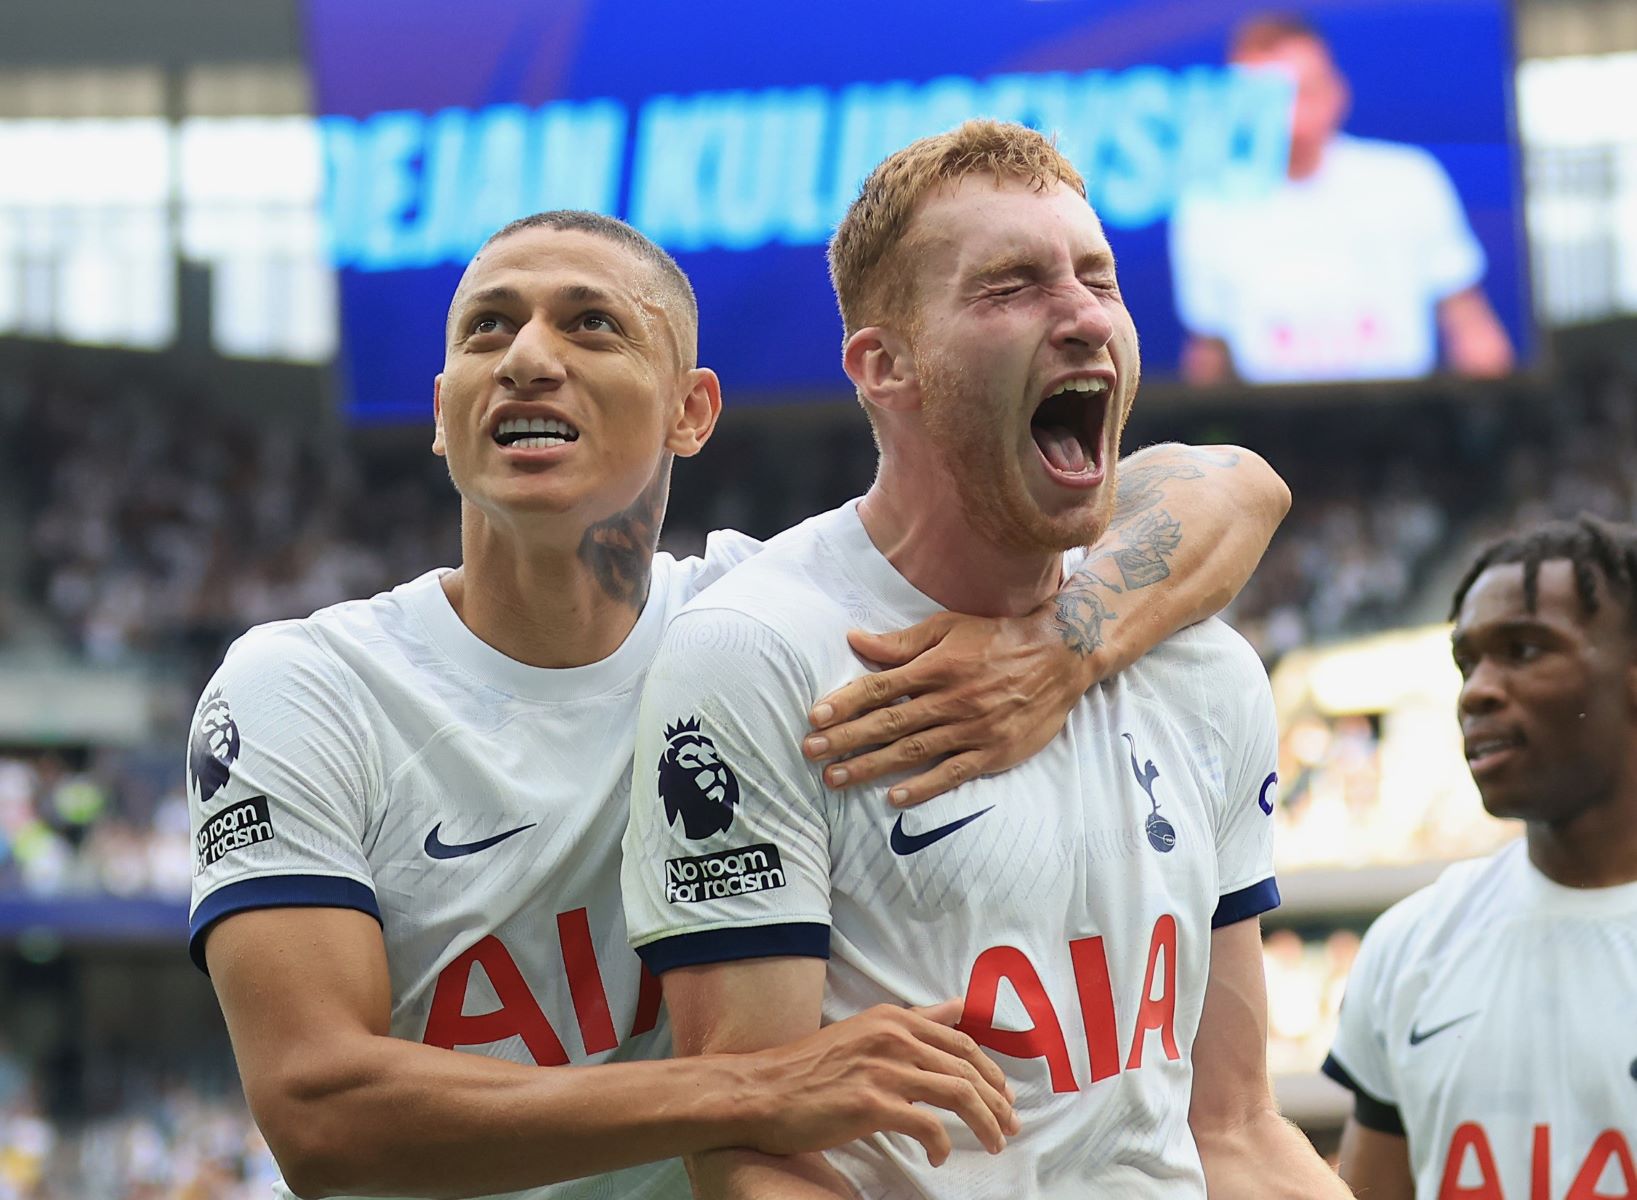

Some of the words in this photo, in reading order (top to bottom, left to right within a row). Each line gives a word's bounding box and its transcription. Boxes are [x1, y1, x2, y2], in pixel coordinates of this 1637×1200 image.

[209, 804, 258, 842] room
[210, 821, 273, 862] racism
[666, 859, 699, 884] No
[699, 850, 769, 879] room
[666, 881, 700, 903] for
[703, 868, 785, 900] racism
[954, 913, 1181, 1094] AIA
